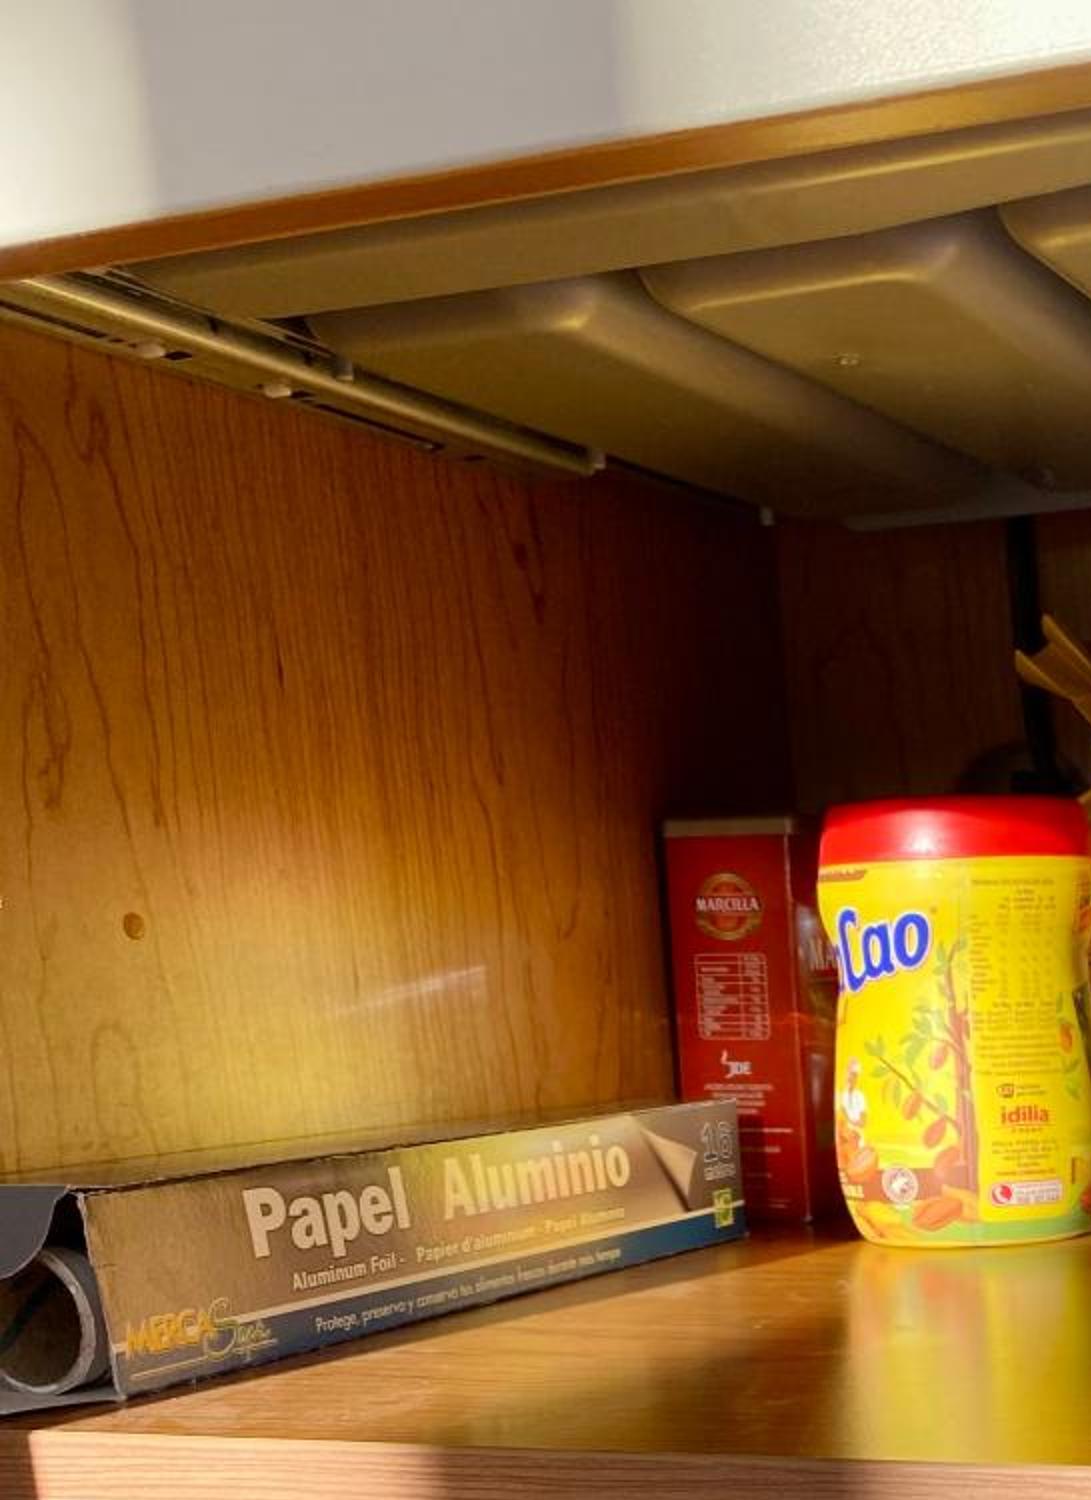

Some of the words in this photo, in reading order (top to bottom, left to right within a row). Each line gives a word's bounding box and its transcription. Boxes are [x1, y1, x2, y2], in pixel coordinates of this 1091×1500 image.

[242, 1167, 411, 1257] Papel
[443, 1134, 631, 1220] Aluminio
[293, 1264, 367, 1290] Aluminum
[371, 1252, 396, 1274] Foil
